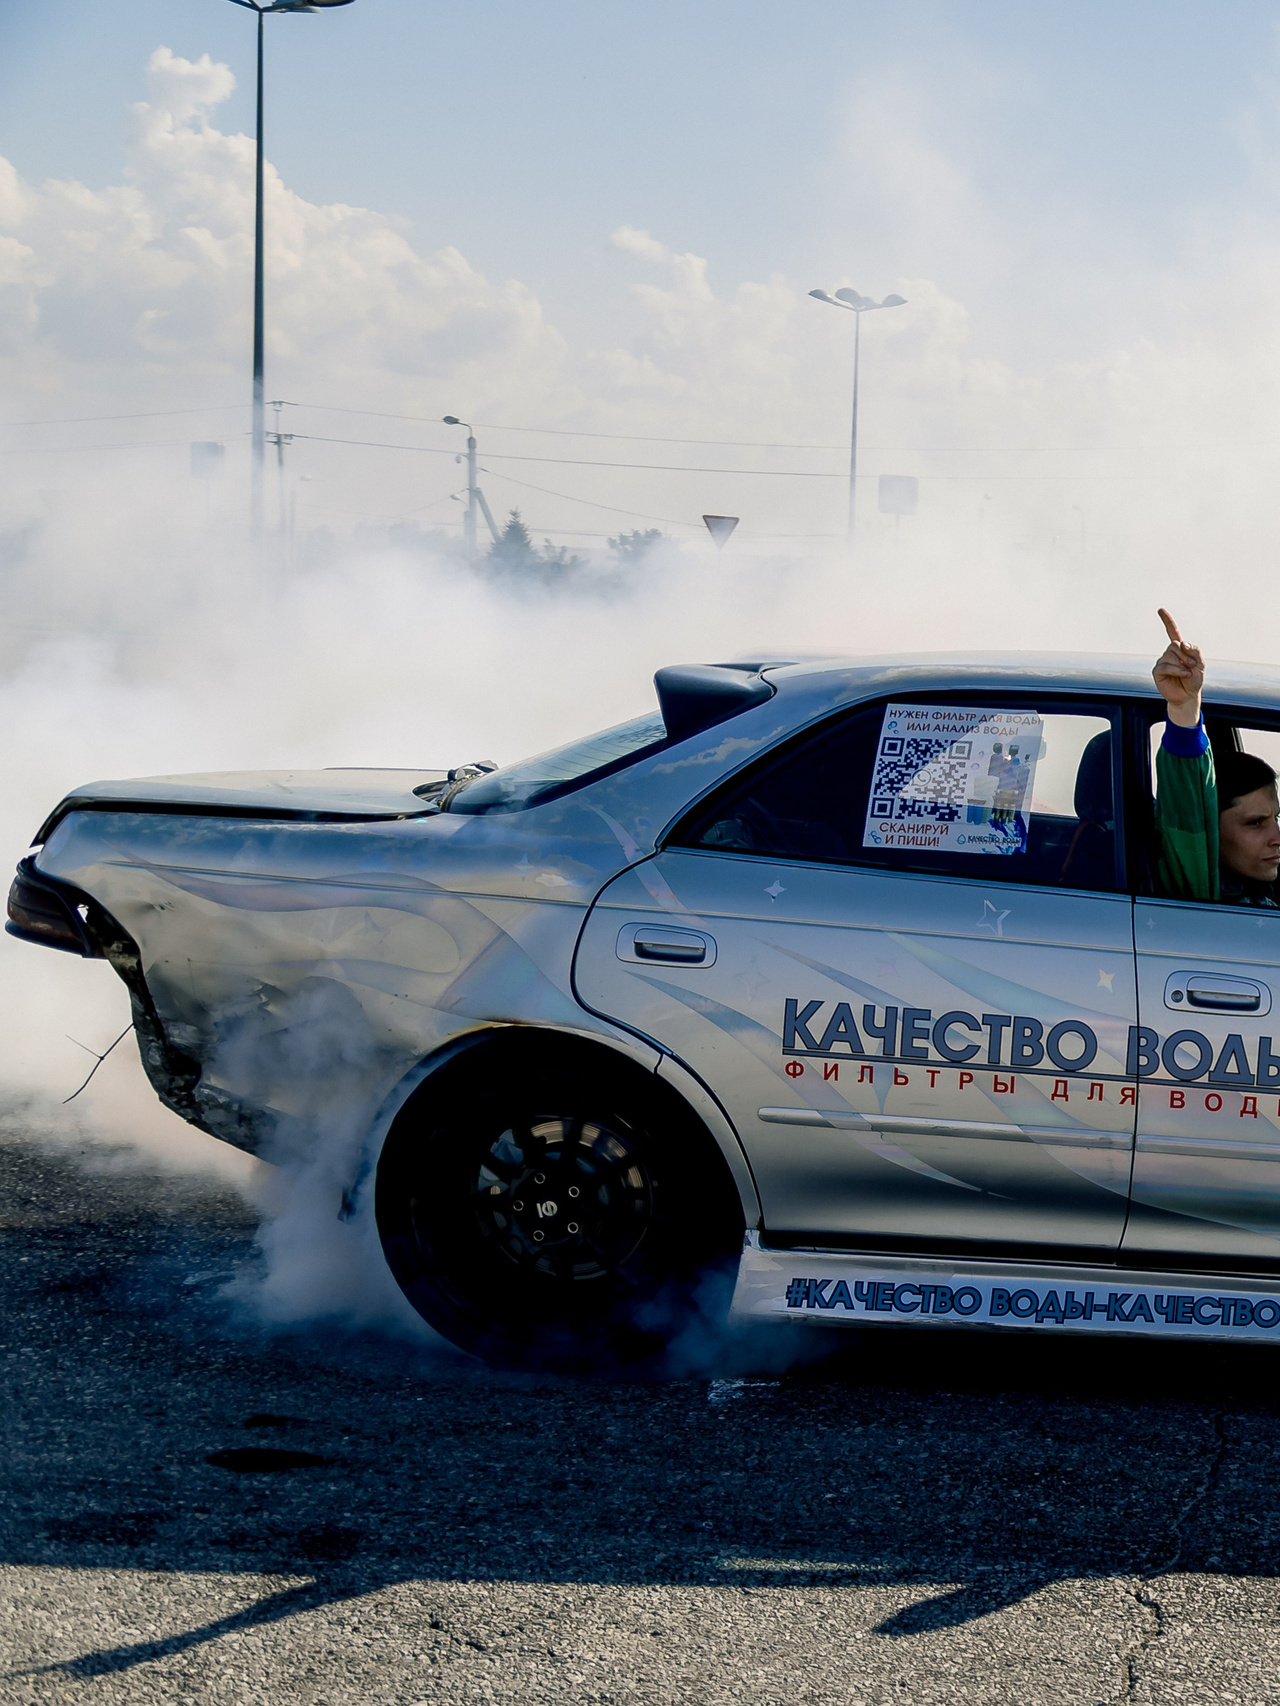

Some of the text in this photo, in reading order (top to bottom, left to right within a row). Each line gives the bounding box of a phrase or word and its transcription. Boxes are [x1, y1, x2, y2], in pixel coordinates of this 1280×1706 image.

[889, 709, 929, 720] НУЖЕН
[931, 710, 977, 722] ФИЛЬТР
[978, 713, 1003, 723] ДЛЯ
[906, 722, 1019, 736] ИЛИ АНАЛИЗ ВОДЫ
[879, 822, 949, 835] СКАНИРУЙ
[885, 834, 940, 847] И ПИШИ!
[782, 998, 1098, 1072] КАЧЕСТВО
[784, 1060, 1015, 1094] ФИЛЬТРЫ
[1050, 1079, 1136, 1106] ДЛЯ
[786, 1278, 983, 1316] #КАЧЕСТВО
